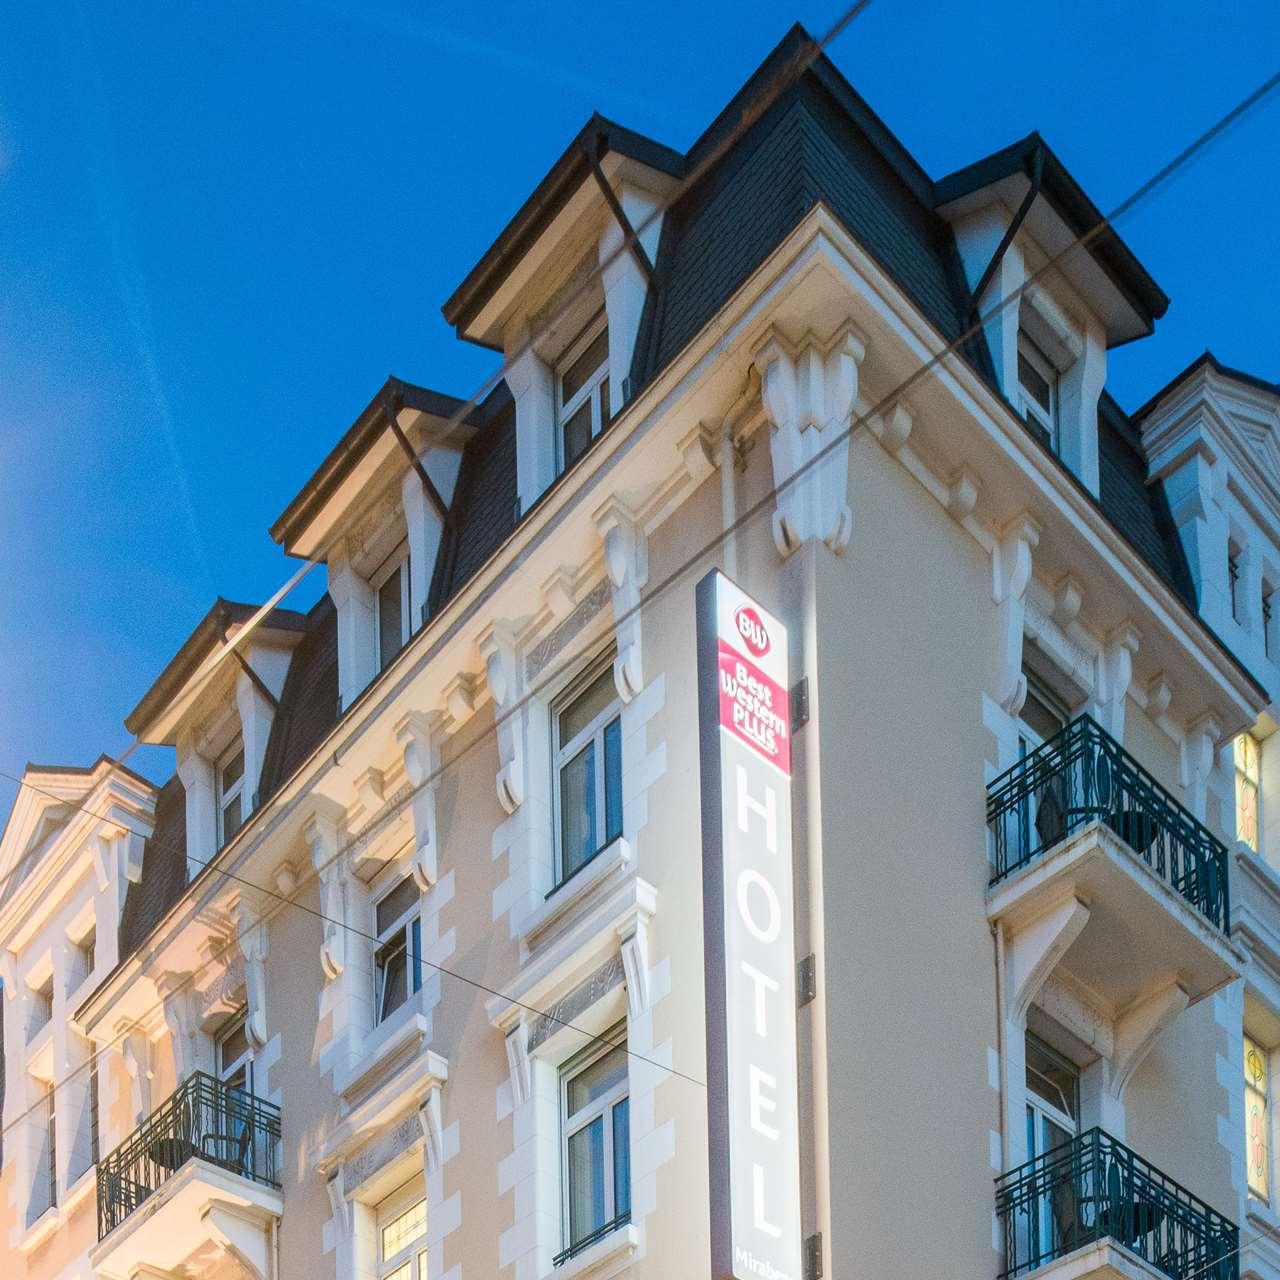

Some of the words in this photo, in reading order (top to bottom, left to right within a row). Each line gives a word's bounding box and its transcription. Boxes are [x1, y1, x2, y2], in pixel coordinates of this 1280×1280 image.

[738, 611, 768, 650] BW
[720, 668, 786, 738] Western
[736, 662, 772, 708] Best
[733, 701, 776, 752] PLUS
[736, 764, 783, 1239] HOTEL
